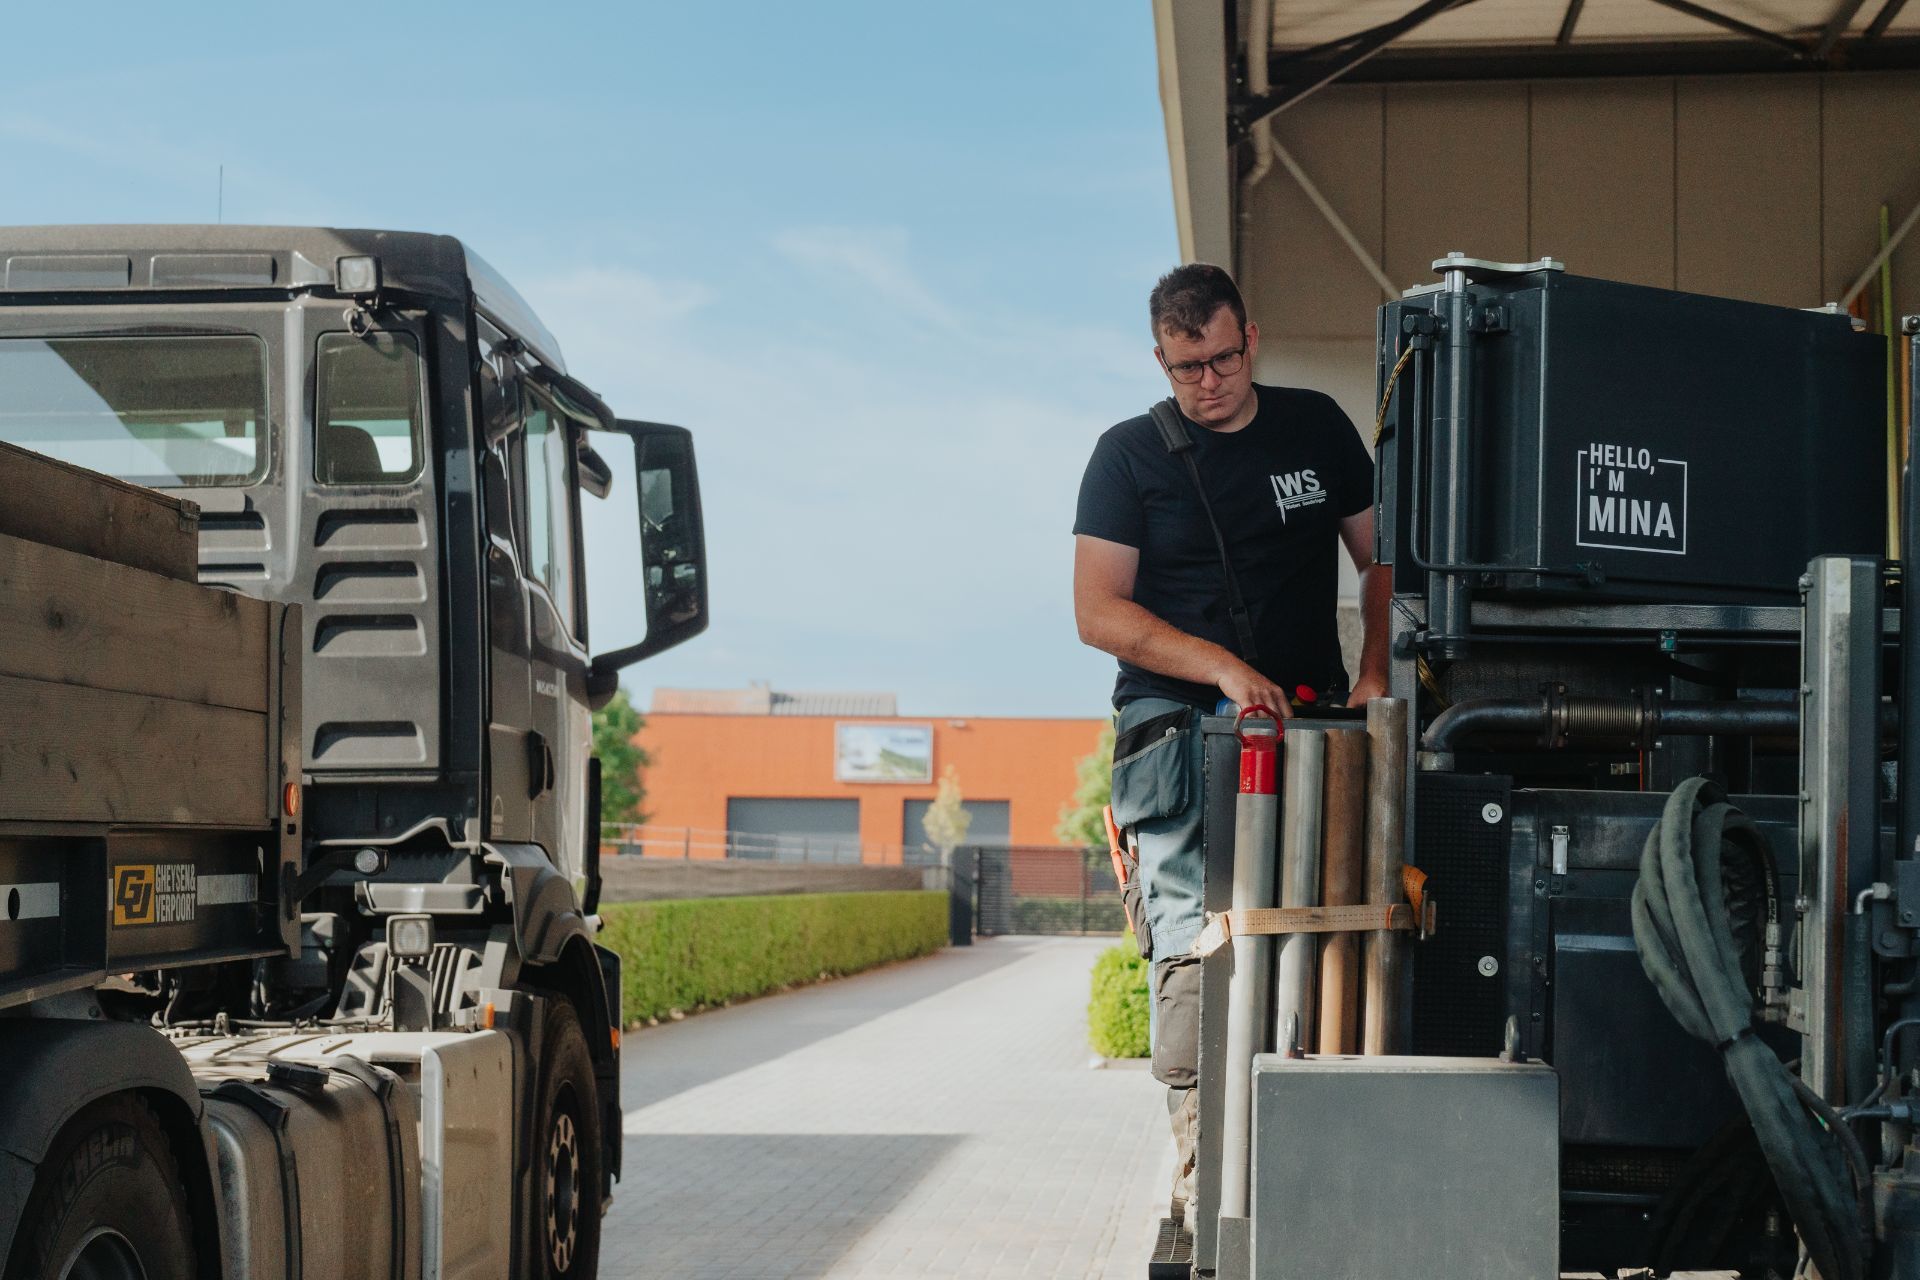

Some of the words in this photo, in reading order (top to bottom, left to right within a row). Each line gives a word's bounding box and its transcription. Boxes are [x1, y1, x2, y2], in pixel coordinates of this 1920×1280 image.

[1590, 443, 1655, 475] HELLO,
[1589, 495, 1675, 538] MINA
[156, 893, 195, 922] VERPOORT
